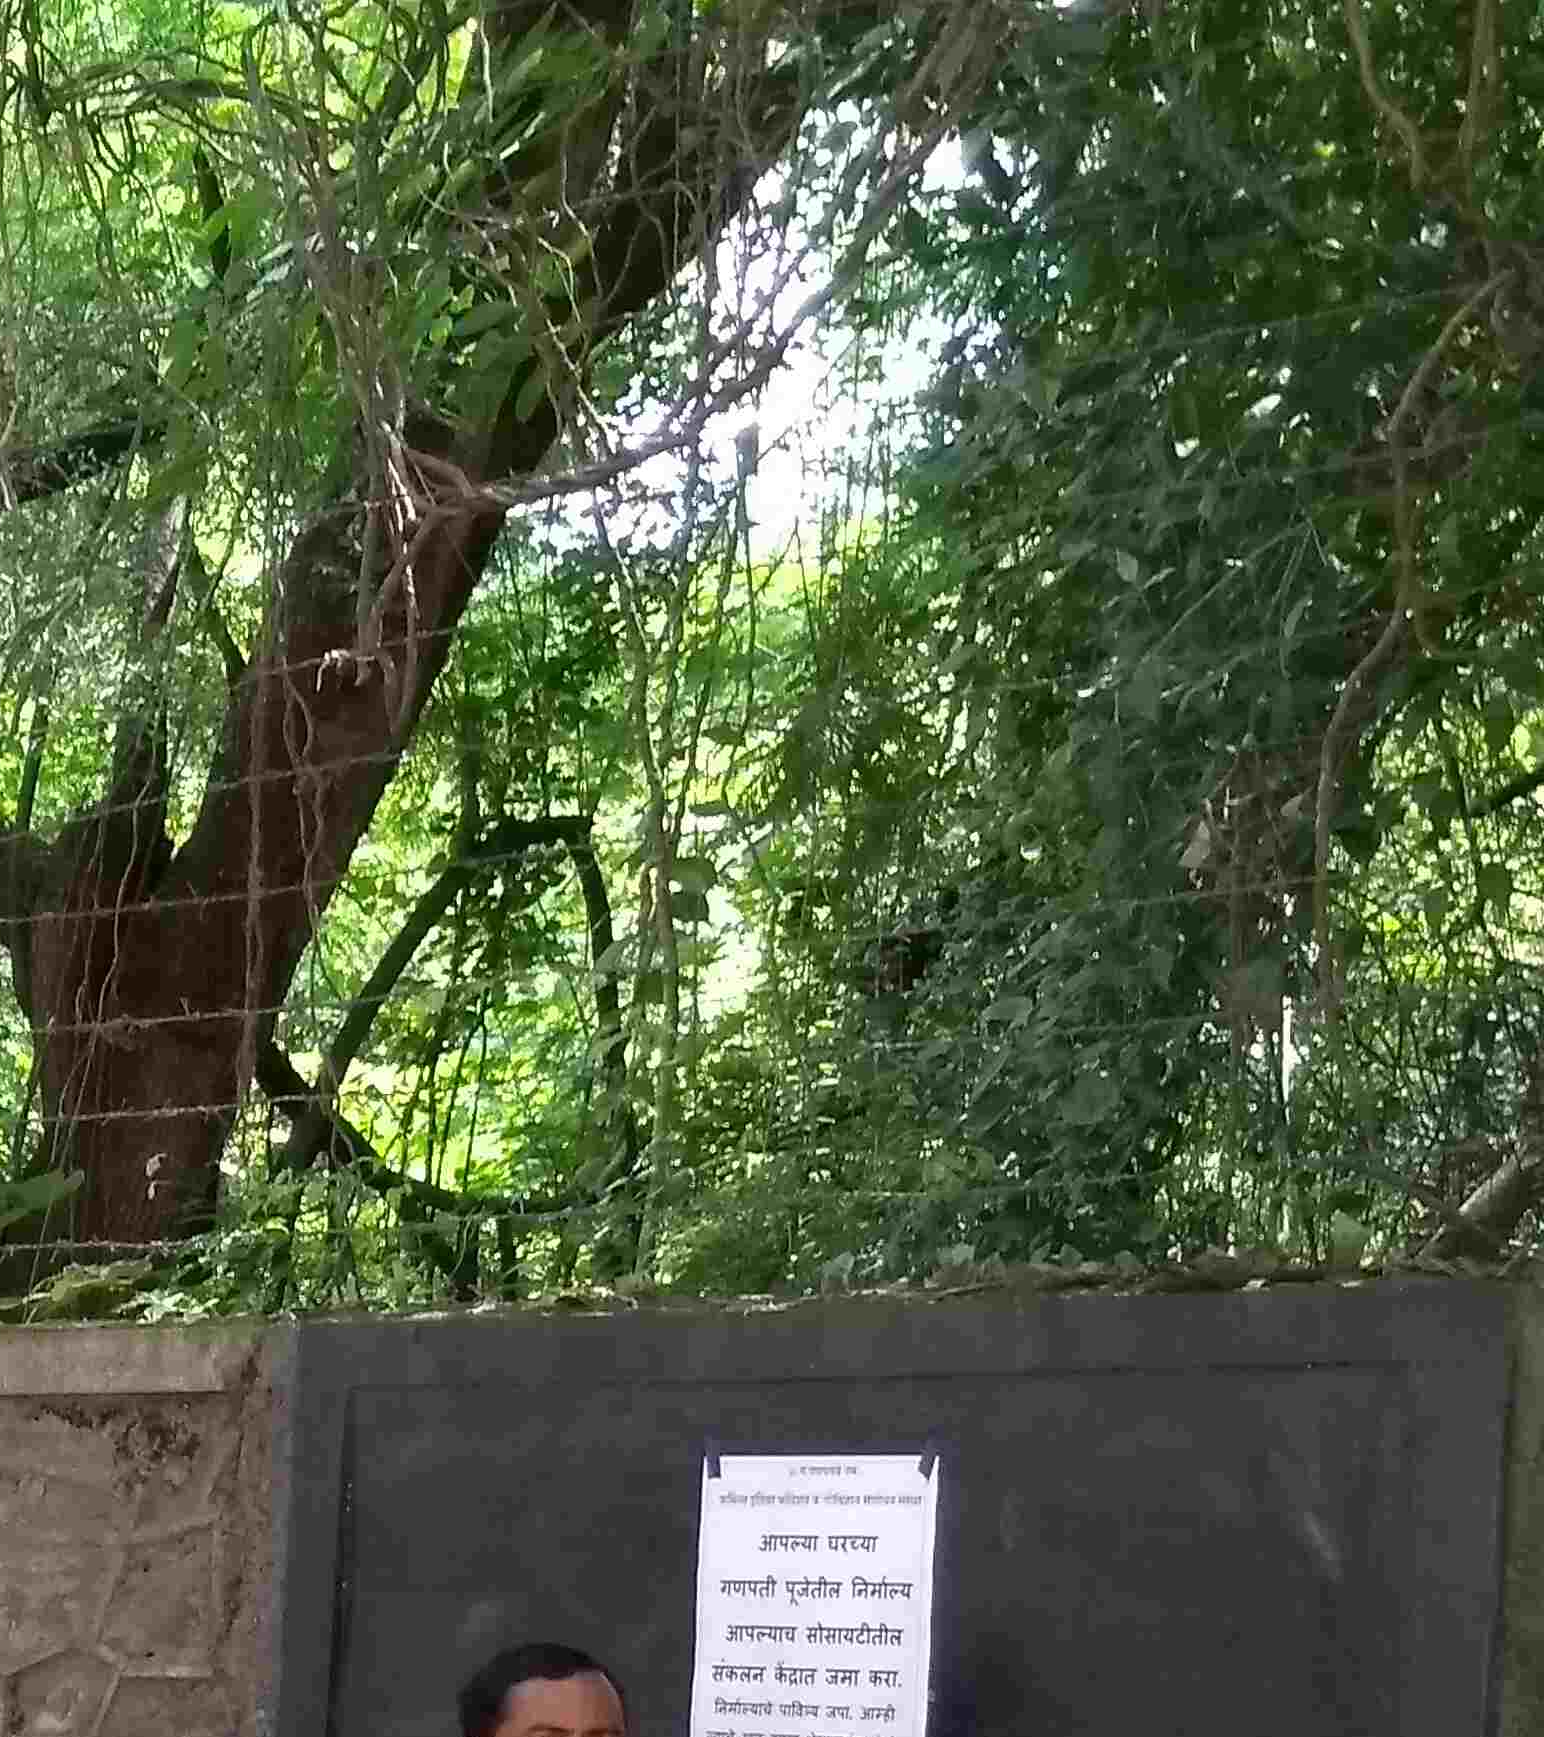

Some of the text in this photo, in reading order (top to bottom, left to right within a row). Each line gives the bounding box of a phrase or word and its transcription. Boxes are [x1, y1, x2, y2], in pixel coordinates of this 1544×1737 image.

[759, 1533, 879, 1553] आपल्या घरच्या
[719, 1575, 914, 1608] गणपती पूजेतील निर्माल्य
[725, 1621, 905, 1646] आपल्याच सोसायटीतील
[711, 1658, 903, 1688] संकलन केंद्रात जमा करा.
[859, 1703, 896, 1724] आम्ही
